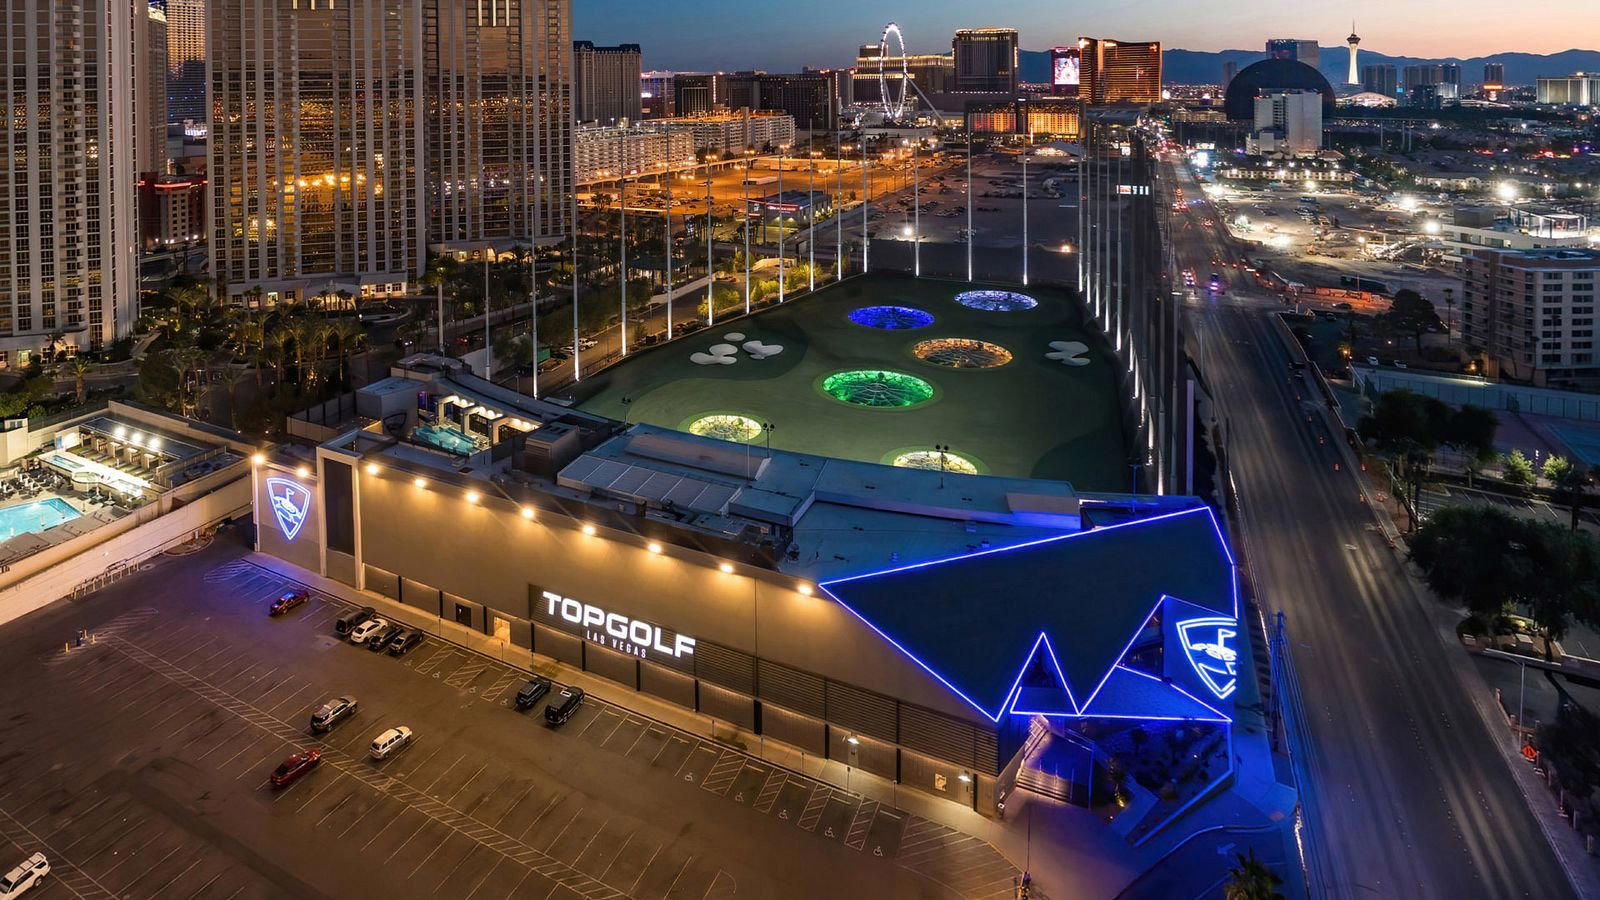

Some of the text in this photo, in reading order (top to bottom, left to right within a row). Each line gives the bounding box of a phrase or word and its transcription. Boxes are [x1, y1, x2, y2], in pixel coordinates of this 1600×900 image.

[542, 591, 696, 658] TOPGOLF
[586, 630, 647, 659] LAS VEGAS
